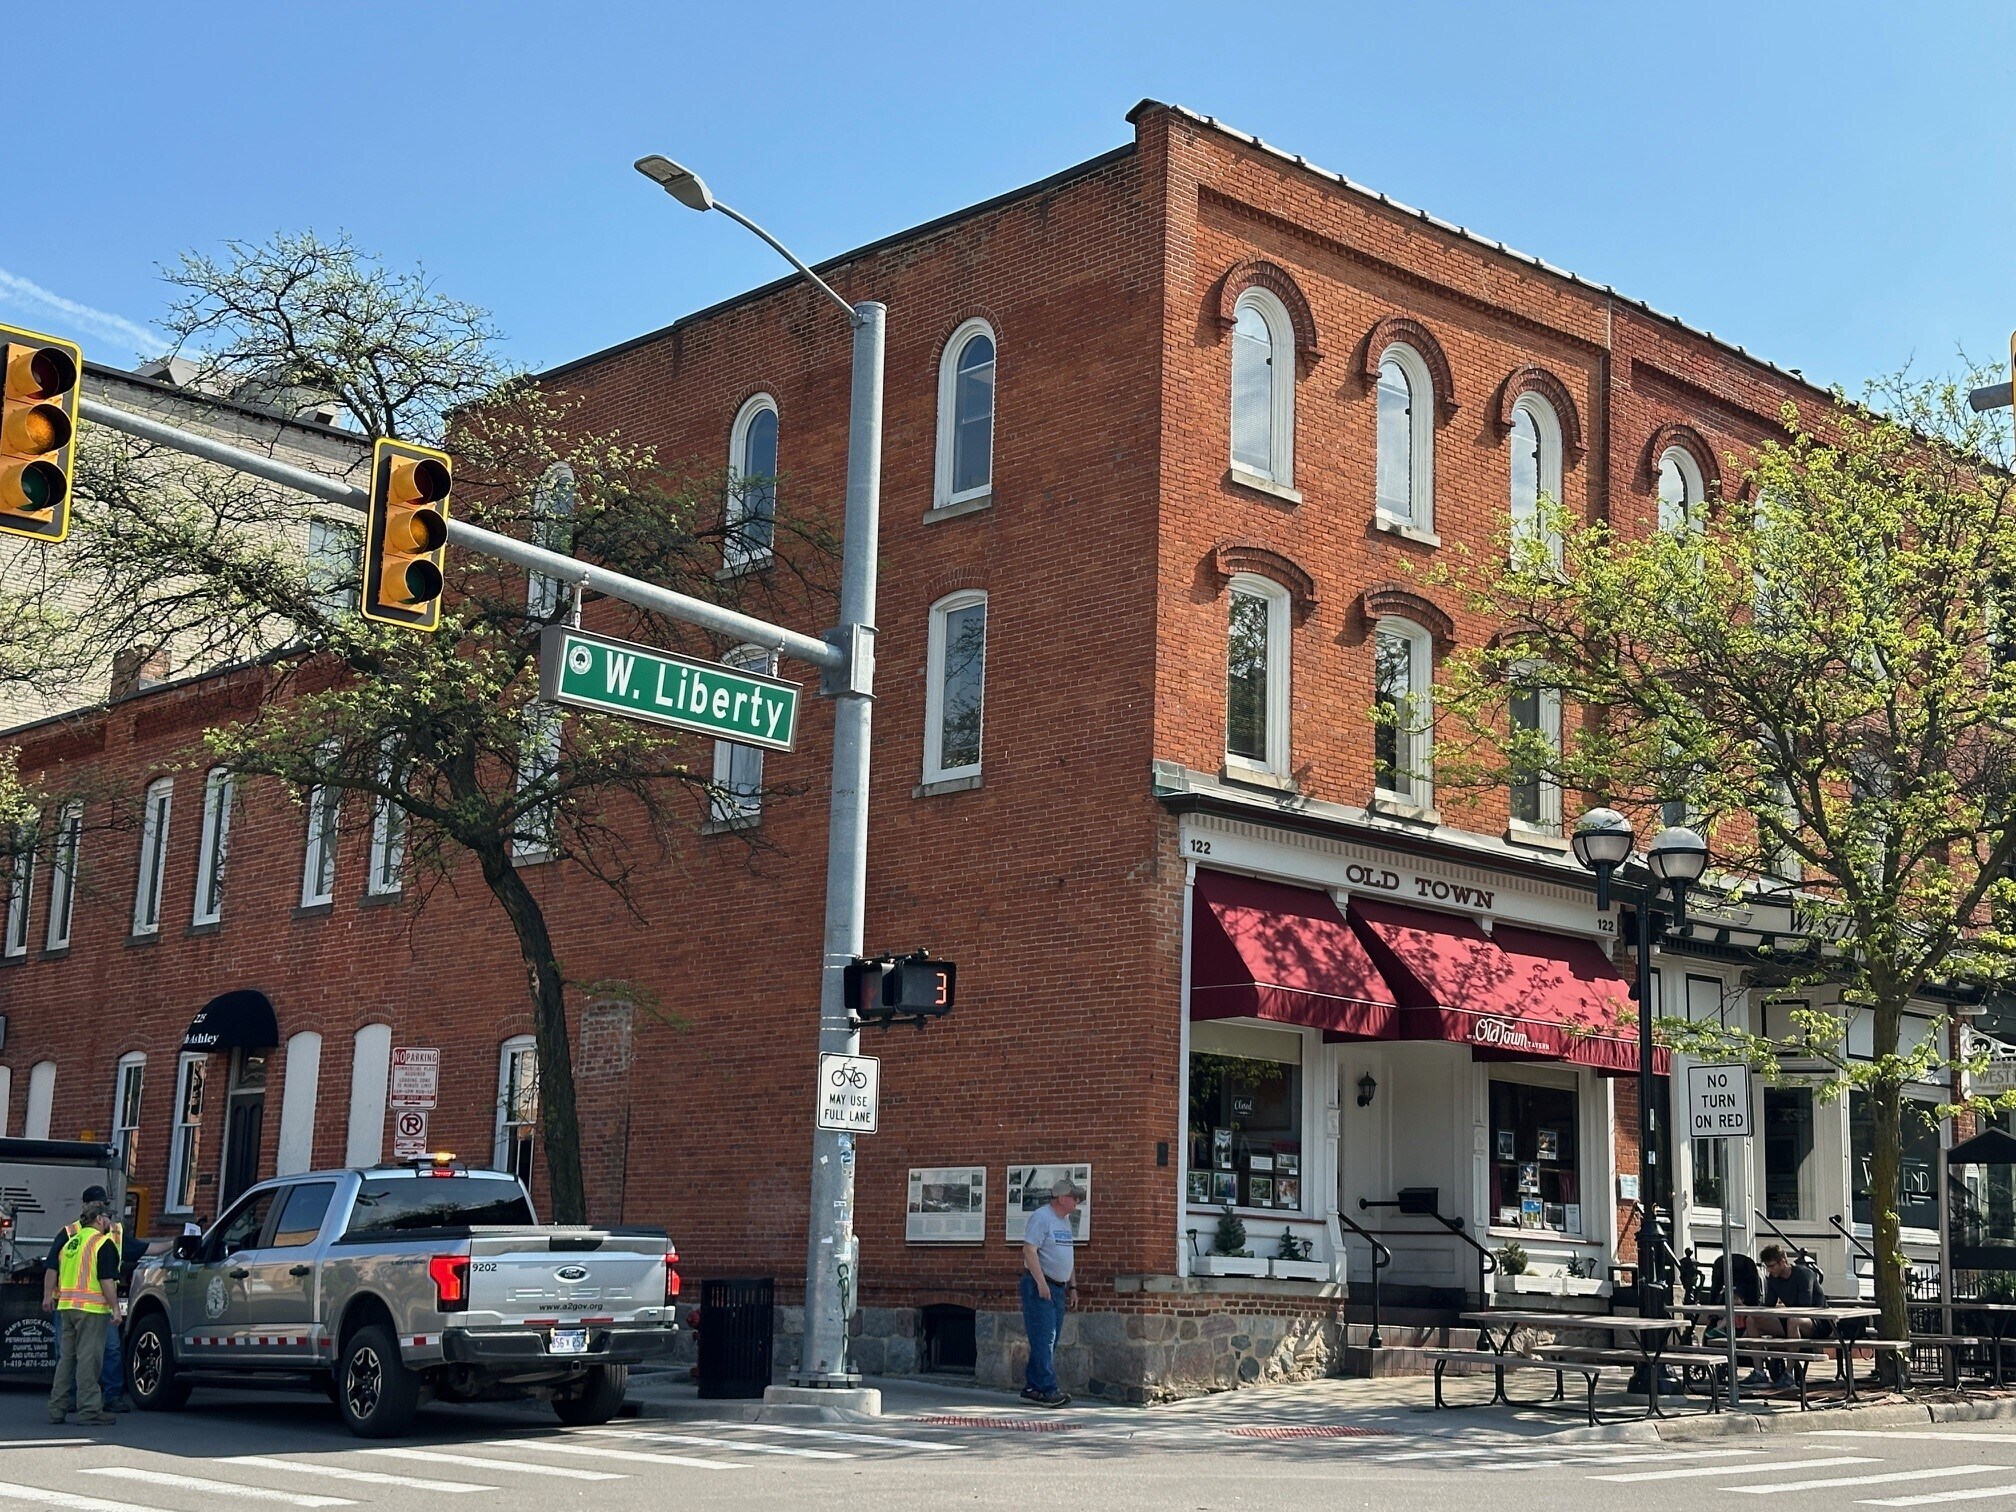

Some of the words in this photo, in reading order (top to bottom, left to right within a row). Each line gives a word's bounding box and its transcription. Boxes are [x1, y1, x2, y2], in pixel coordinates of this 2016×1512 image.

[606, 650, 640, 700] W.
[655, 663, 784, 738] Liberty
[1191, 839, 1211, 855] 122
[1346, 864, 1400, 890] OLD
[1415, 877, 1495, 909] TOWN
[1597, 918, 1614, 932] 122
[935, 972, 947, 1005] 3
[1475, 1018, 1499, 1042] Old
[1485, 1018, 1528, 1049] Town
[190, 1033, 220, 1046] Ashley
[1527, 1041, 1550, 1051] TAVERN
[395, 1050, 406, 1064] NO
[406, 1052, 437, 1063] PARKING
[1707, 1074, 1727, 1088] NO
[829, 1093, 847, 1105] MAY
[850, 1095, 868, 1107] USE
[1701, 1094, 1736, 1108] TURN
[824, 1108, 845, 1121] FULL
[849, 1110, 871, 1123] LANE
[1695, 1114, 1712, 1128] ON
[1719, 1114, 1743, 1128] RED
[1903, 1167, 1930, 1193] END
[472, 1264, 497, 1272] 9202
[539, 1302, 604, 1312] www.a2gov.org
